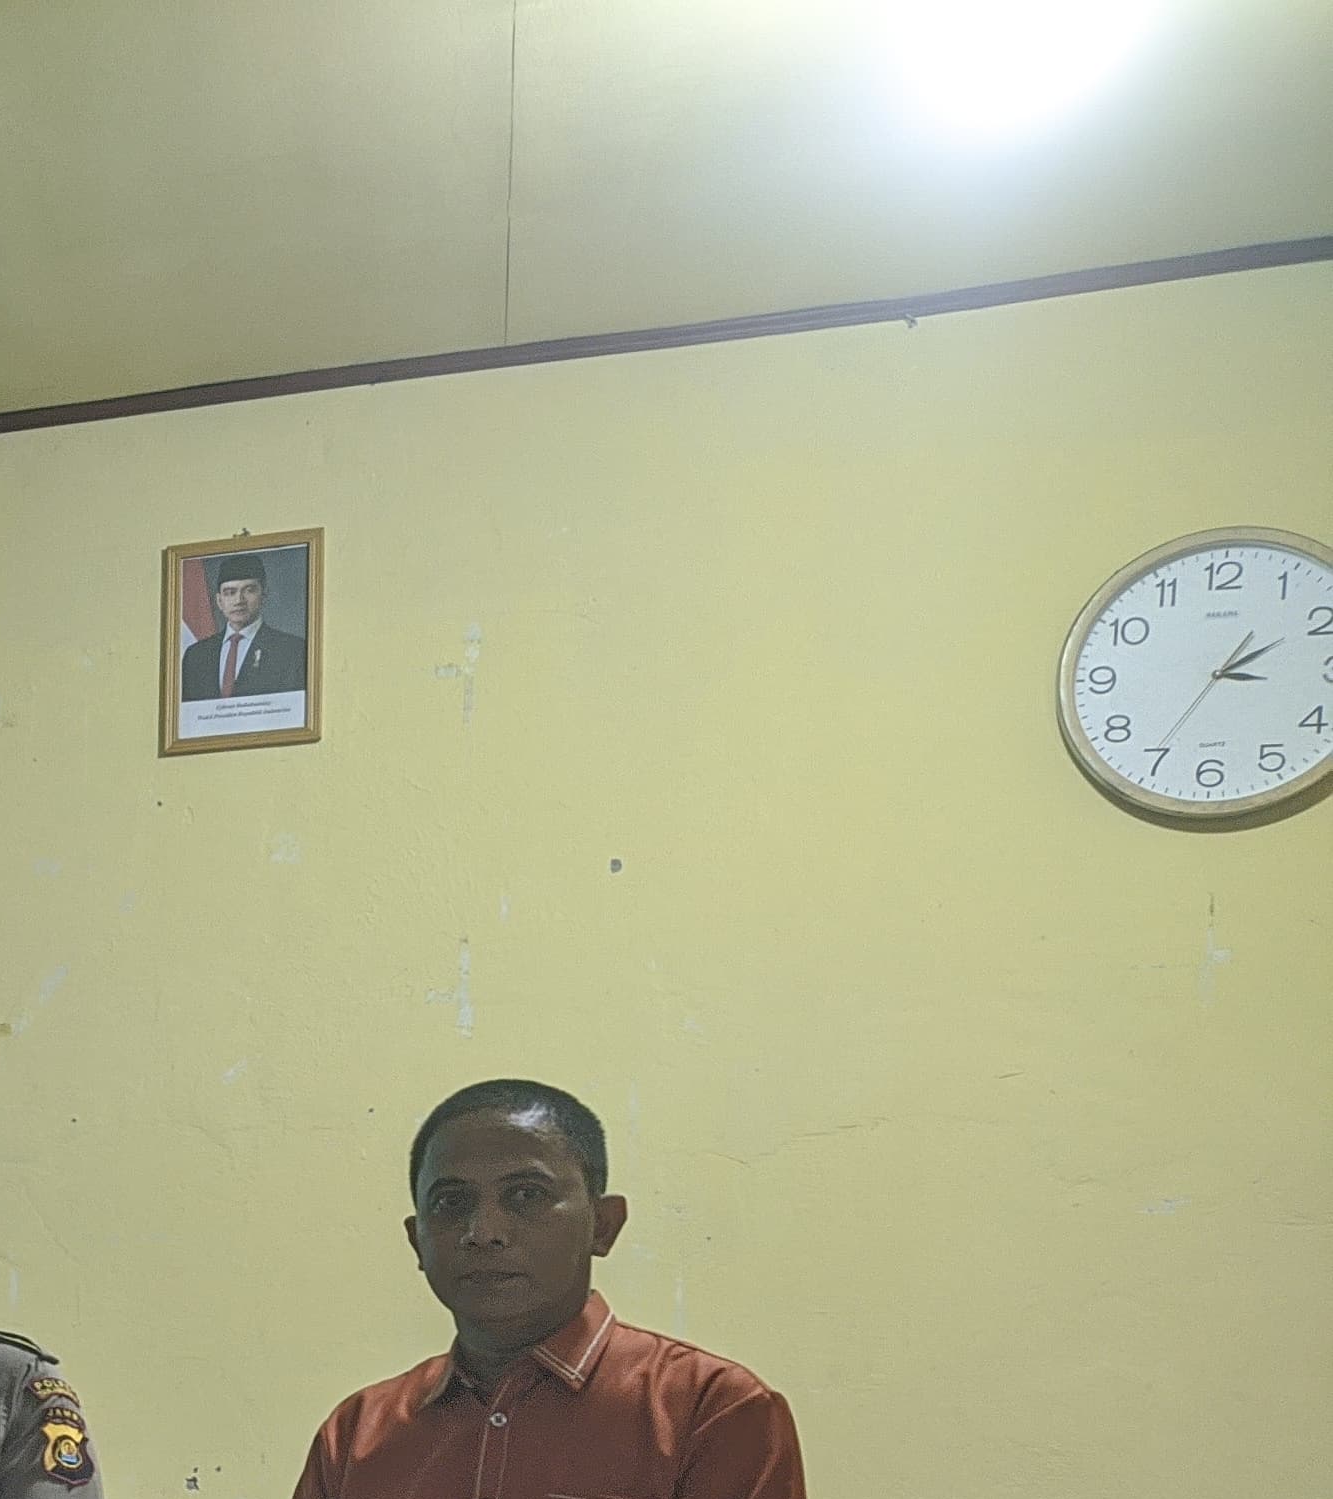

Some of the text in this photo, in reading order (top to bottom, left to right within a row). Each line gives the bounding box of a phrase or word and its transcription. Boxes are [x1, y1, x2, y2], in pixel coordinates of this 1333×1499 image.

[1204, 562, 1243, 591] 12
[1277, 571, 1288, 601] 1
[1156, 578, 1178, 608] 11
[1109, 617, 1150, 647] 10
[1307, 606, 1333, 637] 2
[1089, 665, 1117, 695] 9
[1104, 714, 1132, 743] 8
[1299, 705, 1329, 735] 4
[1144, 748, 1170, 777] 7
[1258, 743, 1286, 773] 5
[1196, 759, 1224, 789] 6
